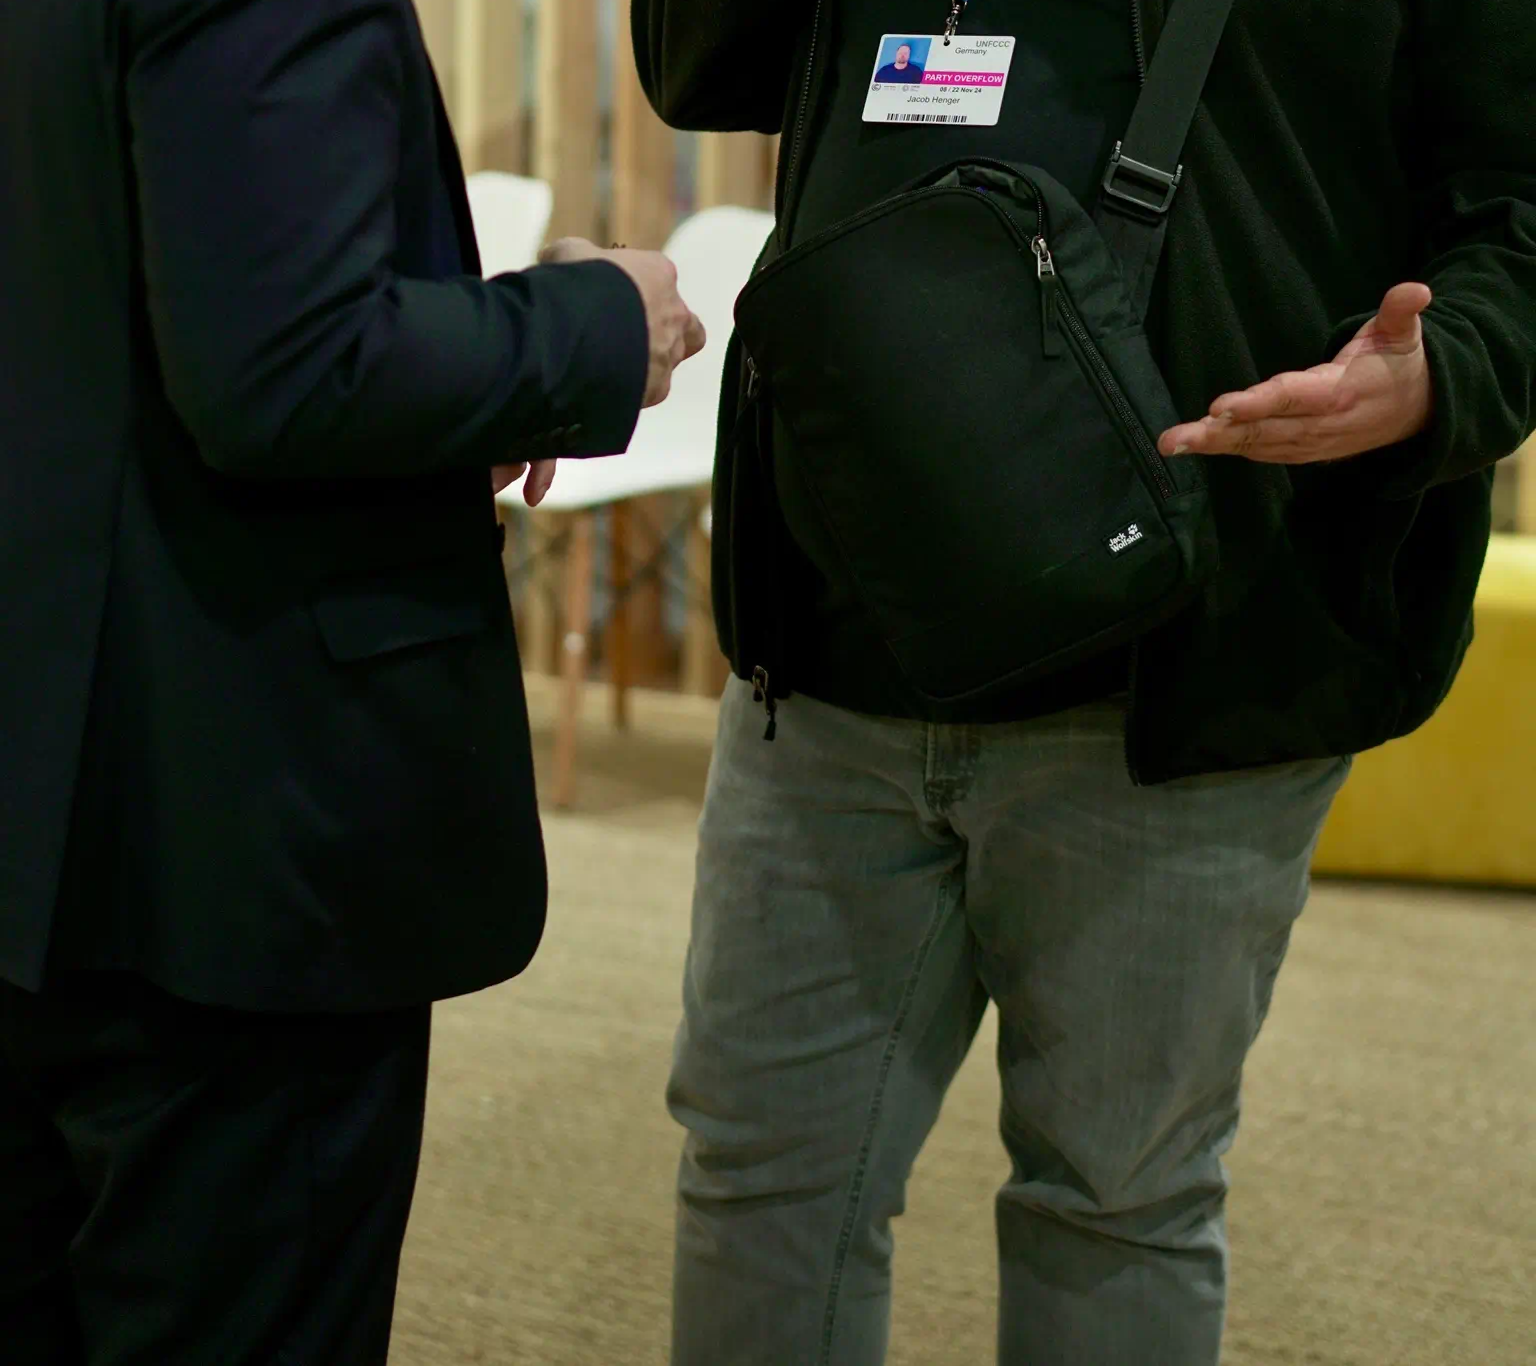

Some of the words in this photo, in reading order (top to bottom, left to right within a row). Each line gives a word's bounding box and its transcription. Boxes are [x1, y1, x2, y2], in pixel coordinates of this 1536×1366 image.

[976, 40, 1010, 48] UNFCCC
[955, 47, 987, 56] Germany
[924, 73, 953, 82] PARTY
[954, 74, 1003, 83] OVERFLOW
[907, 95, 930, 104] Jacob
[931, 96, 961, 106] Henger
[1109, 532, 1126, 547] Jack
[1110, 531, 1143, 553] Wolfskin
